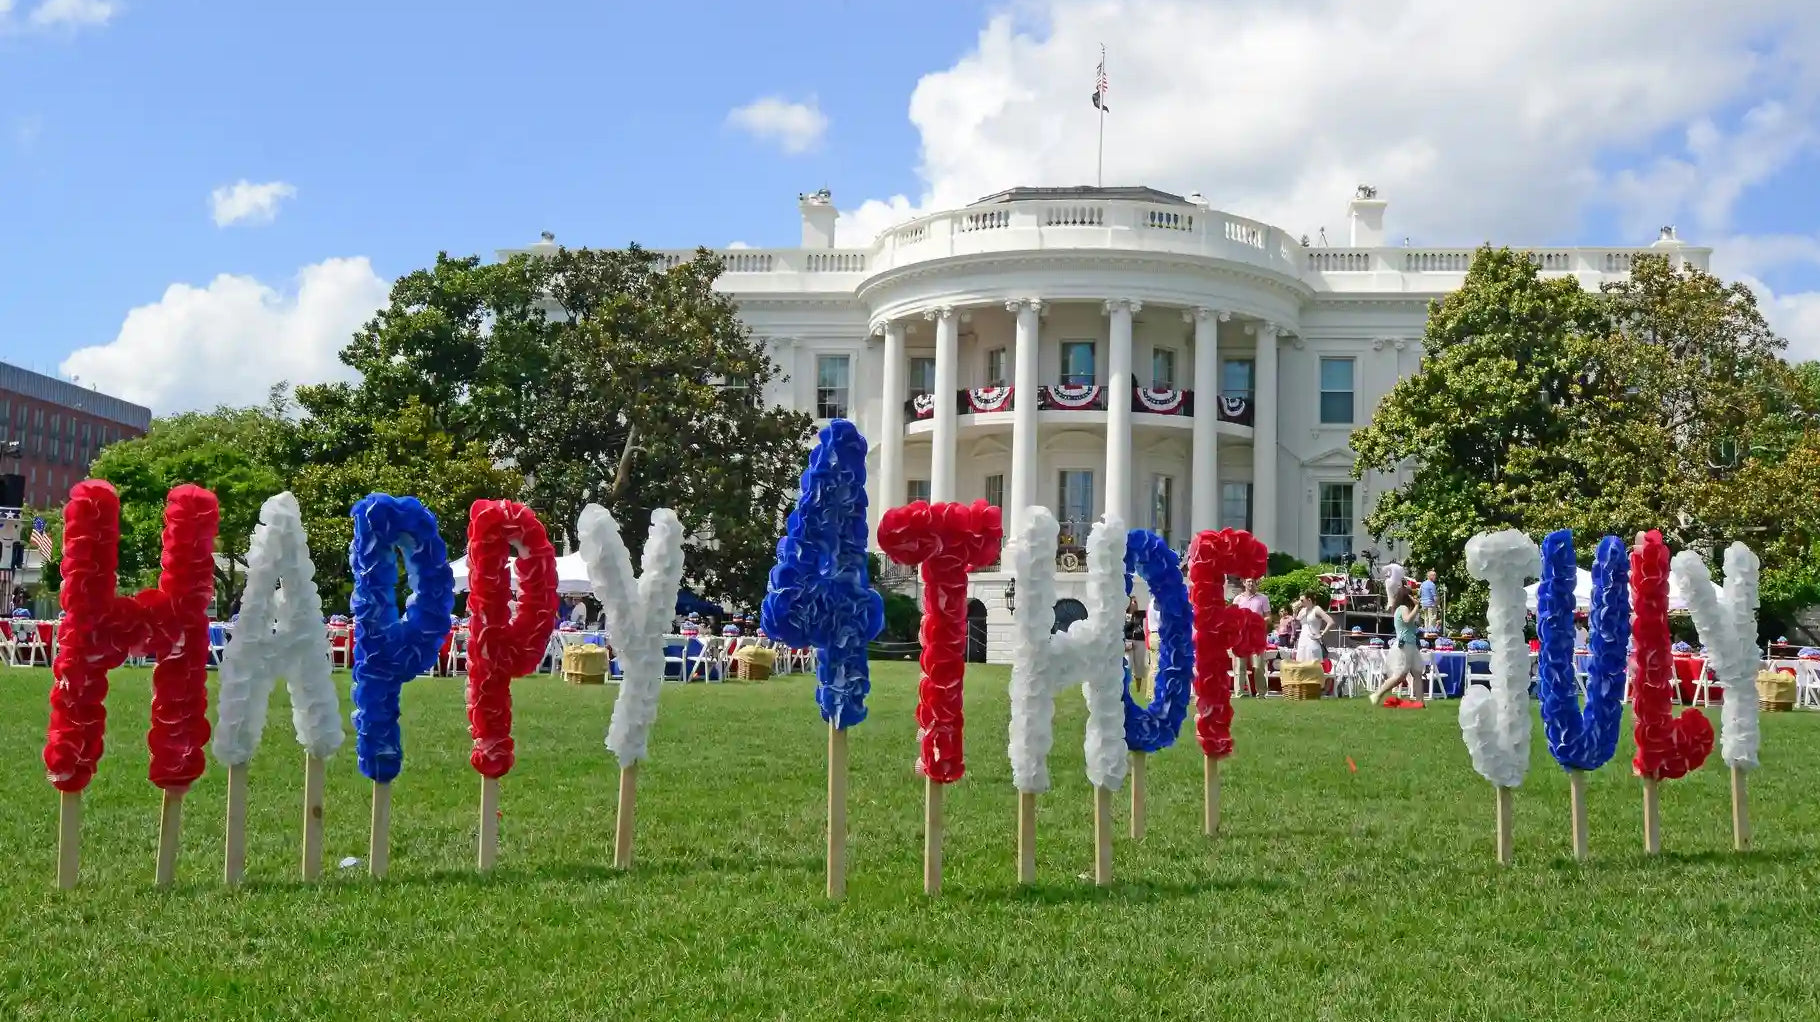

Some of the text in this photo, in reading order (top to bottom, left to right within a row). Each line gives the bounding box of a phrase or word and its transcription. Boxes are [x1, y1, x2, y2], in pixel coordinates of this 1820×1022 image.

[43, 419, 1761, 793] HAPPY 4TH OF JULY
